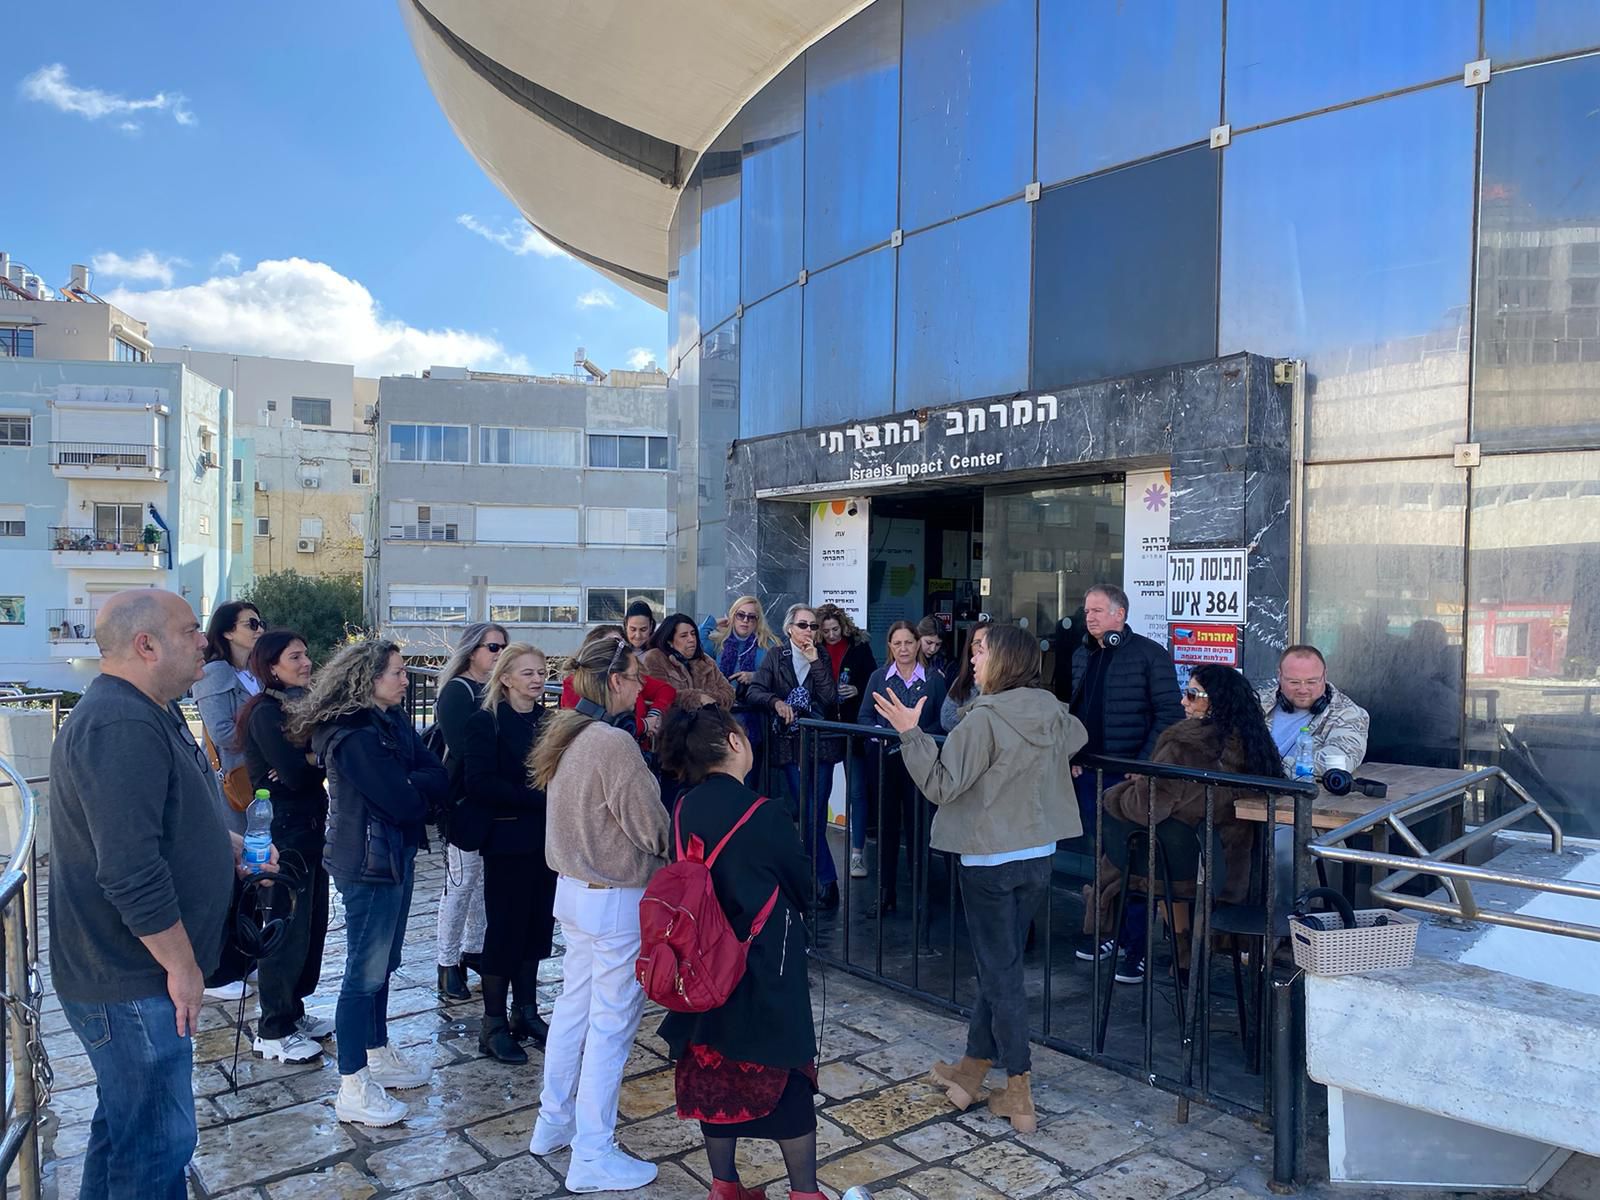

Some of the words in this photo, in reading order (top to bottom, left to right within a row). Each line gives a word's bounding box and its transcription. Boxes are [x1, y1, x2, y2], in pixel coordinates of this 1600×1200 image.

[945, 394, 1058, 437] המרחב
[819, 418, 920, 455] החברתי
[896, 457, 943, 477] Impact
[950, 452, 1003, 469] Center
[1169, 555, 1195, 584] קהל
[1200, 556, 1242, 581] תפוסת
[1171, 591, 1201, 616] איש
[1206, 591, 1239, 613] 384
[1197, 631, 1234, 642] אזהרה!
